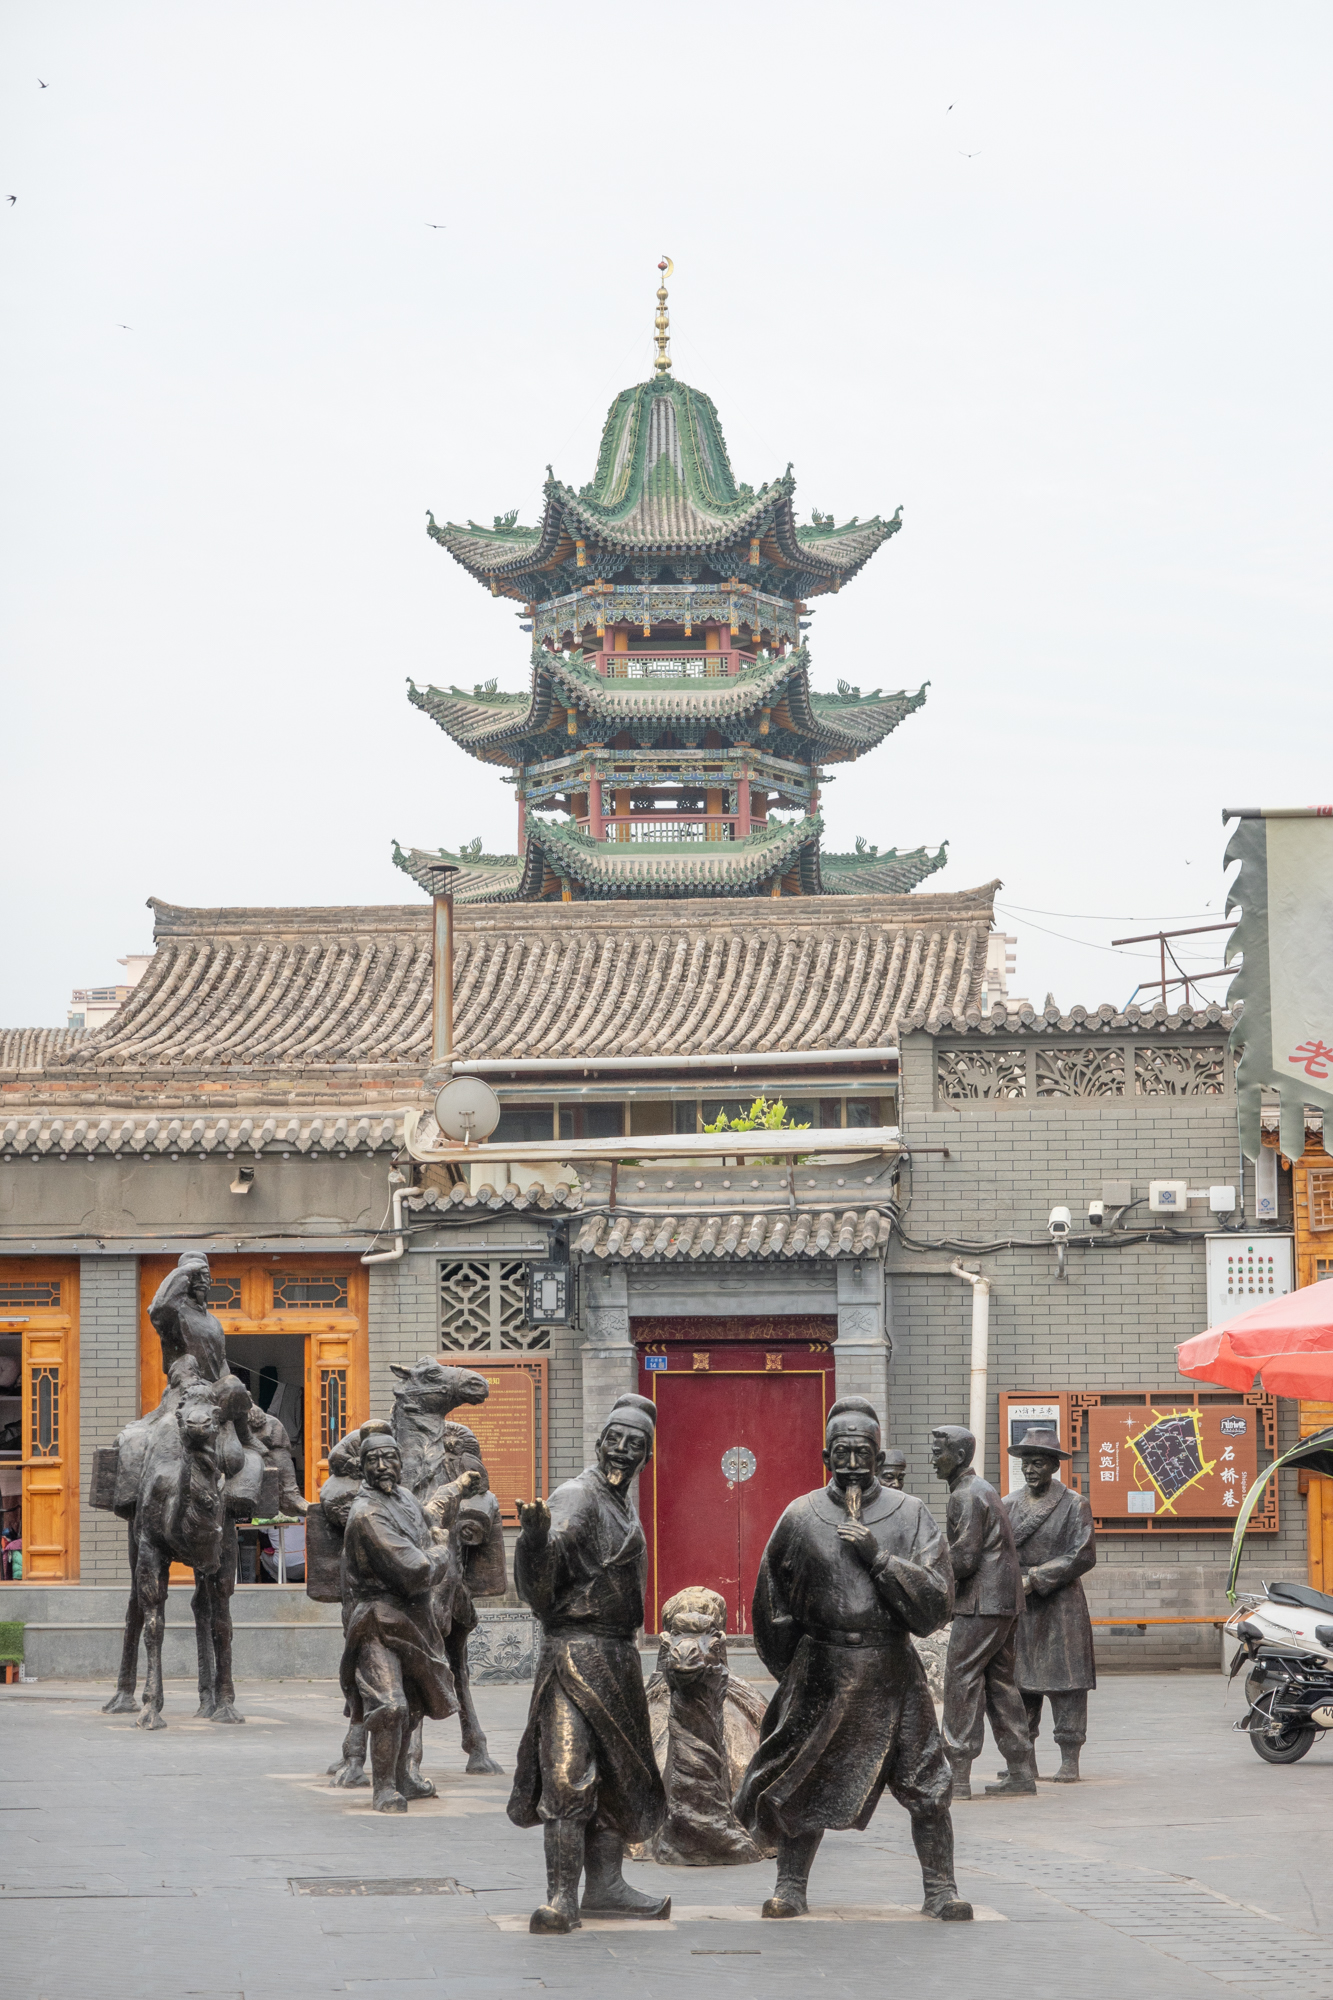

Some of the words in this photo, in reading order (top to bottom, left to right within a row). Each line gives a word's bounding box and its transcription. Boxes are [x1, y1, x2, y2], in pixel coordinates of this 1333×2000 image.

[1289, 1040, 1333, 1079] 老
[1098, 1441, 1116, 1482] 总览图
[1219, 1445, 1240, 1508] 石桥巷
